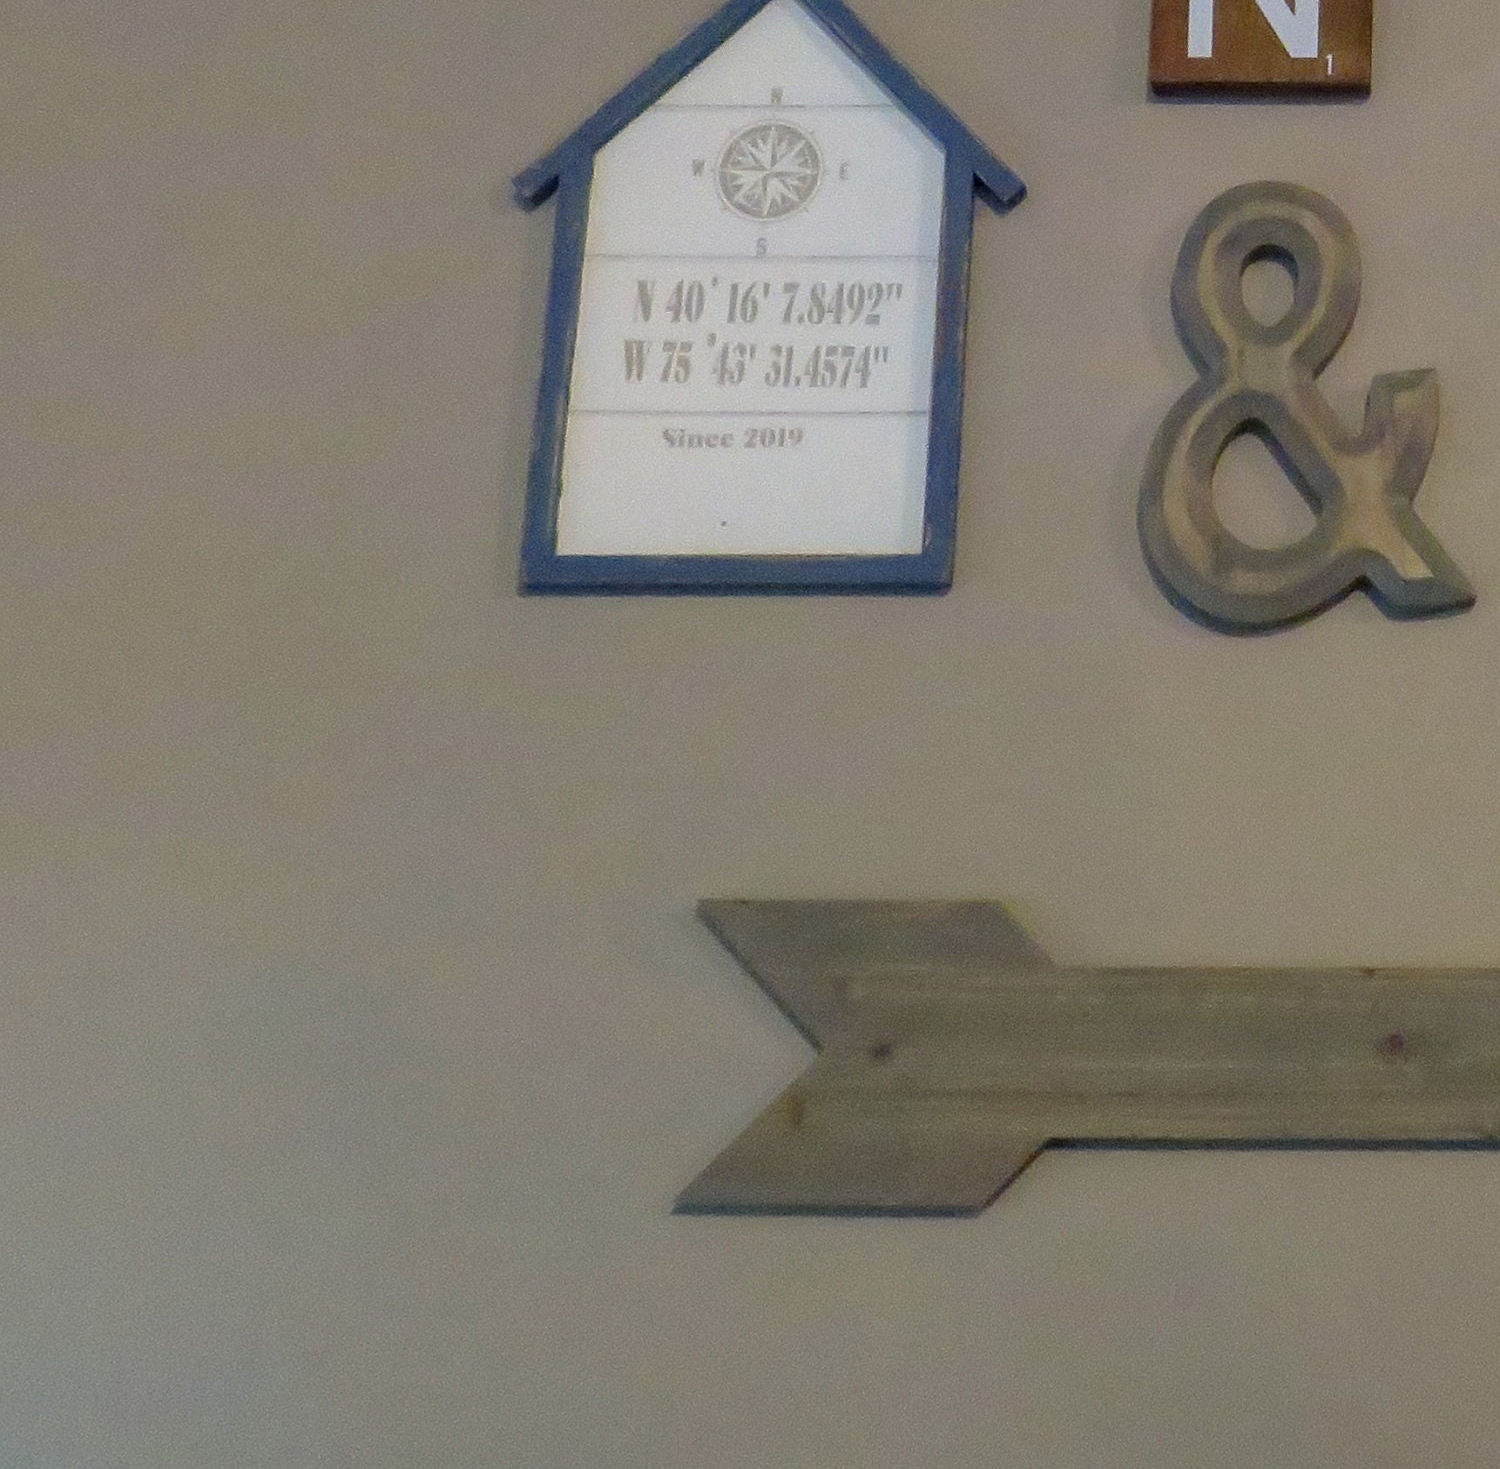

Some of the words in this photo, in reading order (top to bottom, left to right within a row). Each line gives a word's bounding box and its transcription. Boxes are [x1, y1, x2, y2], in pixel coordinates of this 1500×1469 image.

[633, 280, 655, 322] N
[623, 340, 646, 382] W
[662, 427, 735, 449] Since
